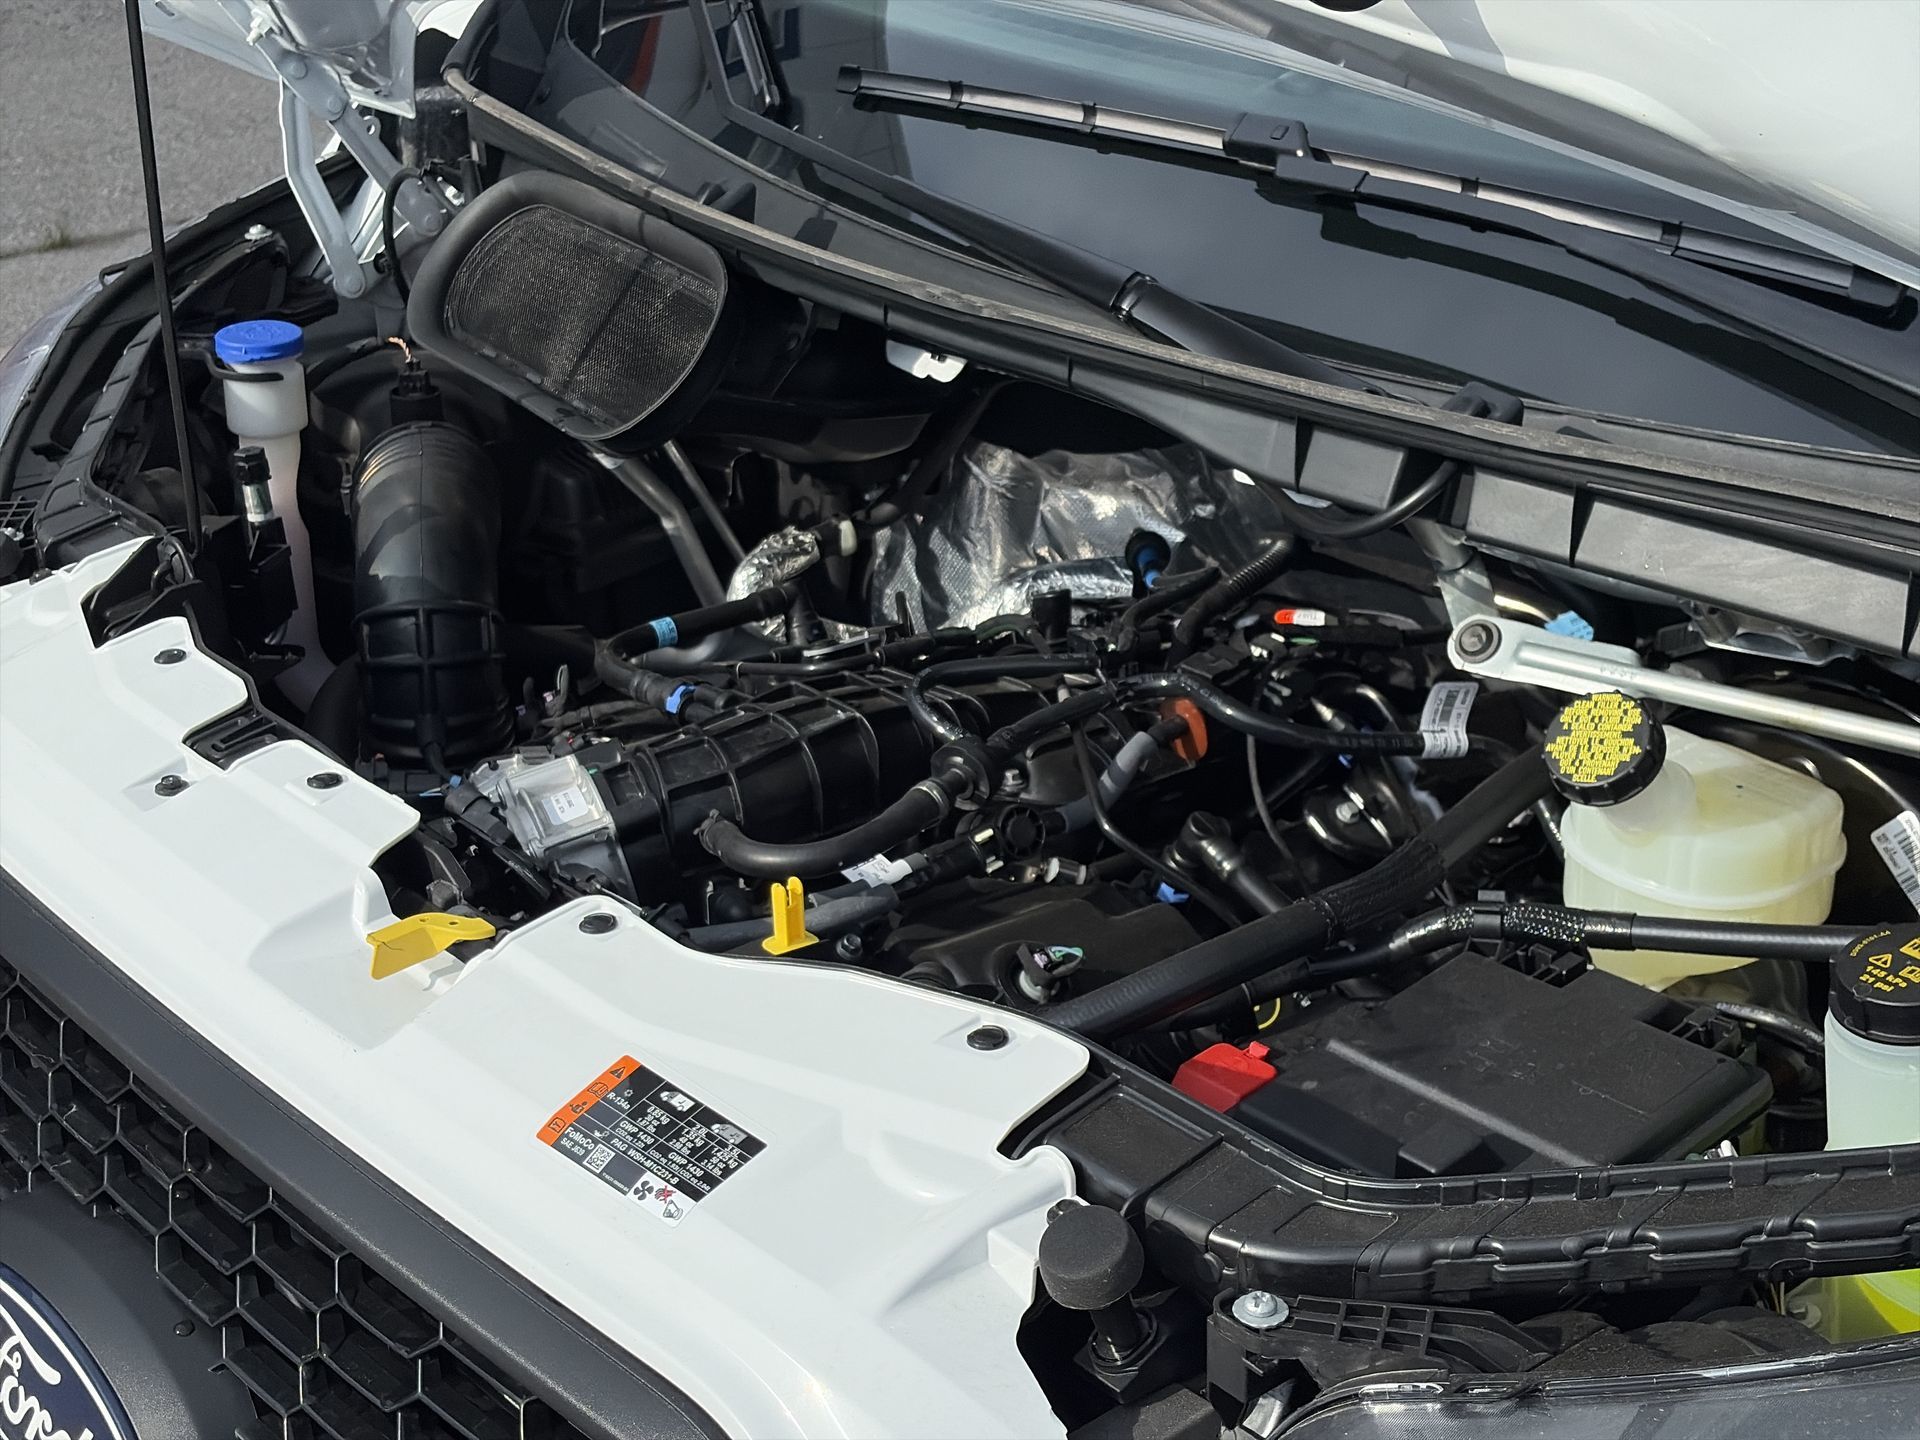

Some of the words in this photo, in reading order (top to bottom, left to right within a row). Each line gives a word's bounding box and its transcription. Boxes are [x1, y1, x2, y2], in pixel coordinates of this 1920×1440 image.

[1564, 707, 1588, 715] BEFORE
[1628, 708, 1641, 716] USE
[1560, 715, 1577, 723] ONLY
[1580, 715, 1591, 723] DOT
[1601, 715, 1620, 723] FLUID
[1623, 716, 1641, 724] FROM
[1571, 723, 1595, 731] SEALED
[1546, 743, 1567, 752] AVANT
[1592, 737, 1599, 745] LE
[1859, 973, 1875, 984] 21
[1873, 981, 1894, 993] psi
[1866, 965, 1887, 978] 145
[1886, 974, 1907, 988] kPa
[607, 1092, 631, 1109] R-134a
[647, 1107, 662, 1117] 0.85
[659, 1115, 670, 1124] kg
[615, 1128, 627, 1136] CO2
[619, 1120, 637, 1133] GWP
[636, 1131, 654, 1144] 1430
[636, 1117, 649, 1127] 1.87
[647, 1124, 657, 1132] lbs
[560, 1138, 573, 1147] SAE
[565, 1127, 596, 1149] FoMoCo
[682, 1129, 696, 1139] 1.35
[693, 1137, 705, 1146] kg
[649, 1150, 661, 1158] CO2
[681, 1146, 691, 1154] lbs
[711, 1147, 730, 1160] 1.425
[725, 1158, 739, 1168] kg
[725, 1145, 742, 1157] 3.5L
[611, 1138, 628, 1150] PAG
[627, 1148, 679, 1184] WSH-M1C231-B
[668, 1152, 687, 1165] GWP
[686, 1163, 704, 1176] 1430
[701, 1160, 715, 1170] 3.14
[713, 1167, 723, 1175] lbs
[680, 1169, 692, 1178] CO2
[0, 1303, 94, 1440] or
